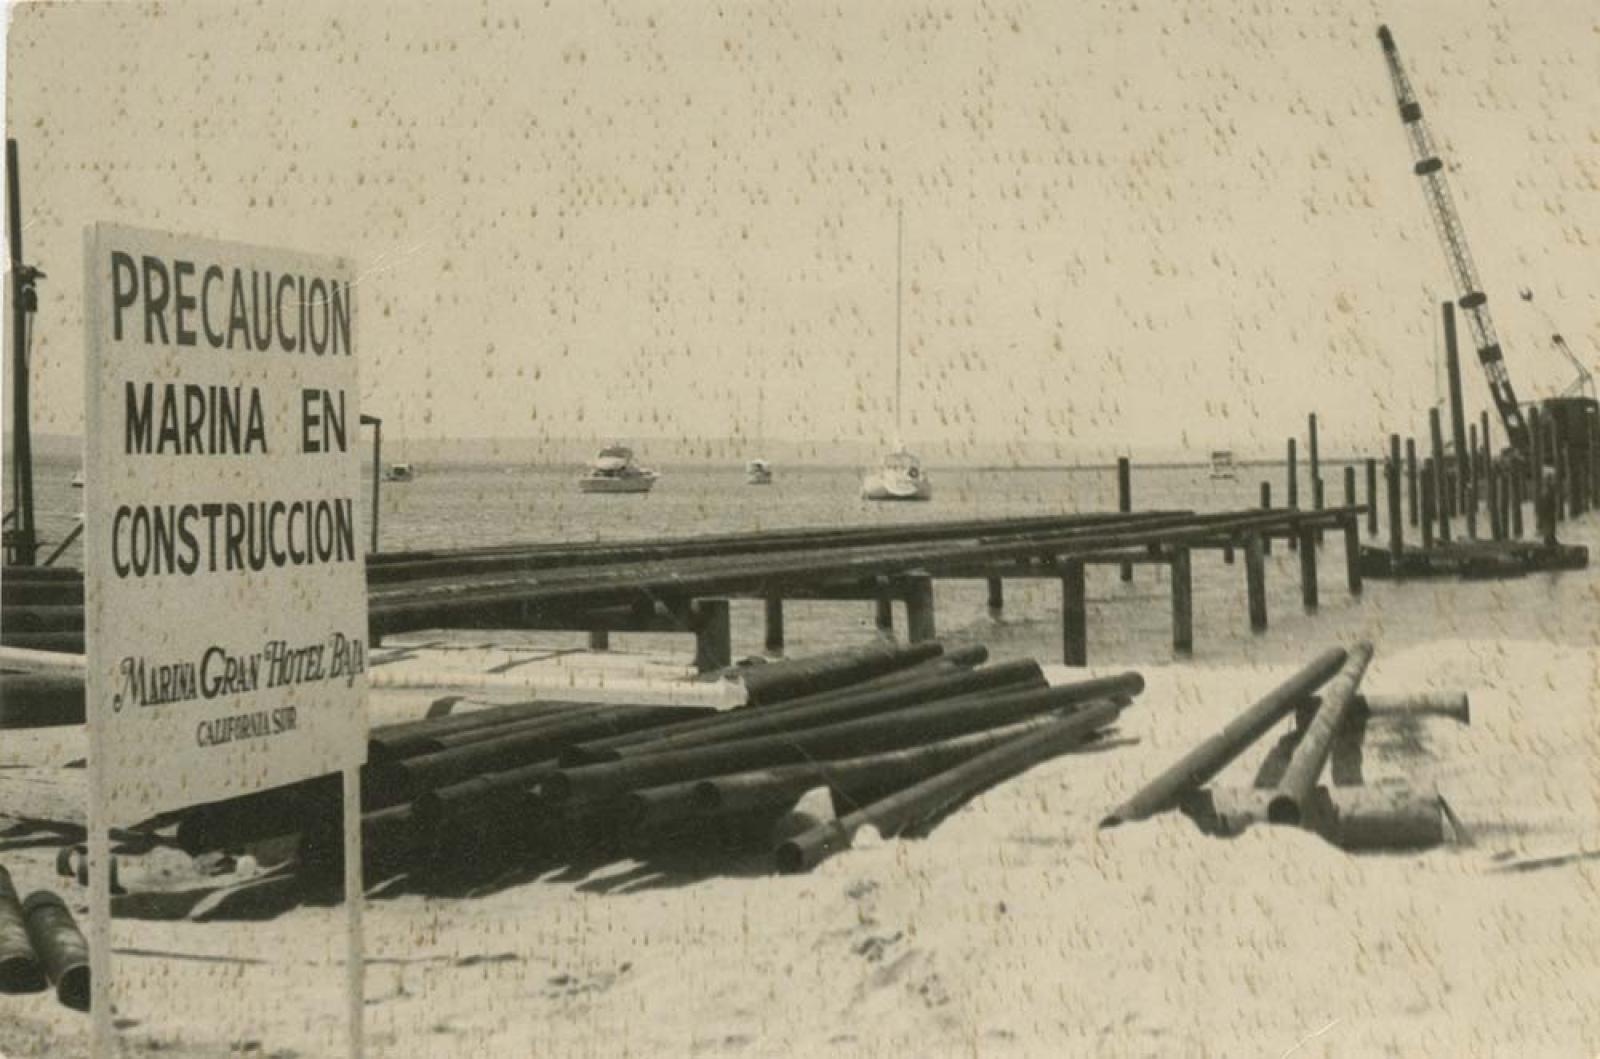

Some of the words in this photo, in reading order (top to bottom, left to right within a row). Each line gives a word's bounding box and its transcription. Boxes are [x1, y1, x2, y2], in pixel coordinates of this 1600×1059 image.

[111, 250, 352, 356] PRECAUCION
[125, 381, 267, 455] MARINA
[302, 388, 347, 453] EN
[112, 498, 355, 578] CONSTRUCCION
[197, 710, 271, 747] CALIFORNIA
[272, 706, 297, 734] SUR
